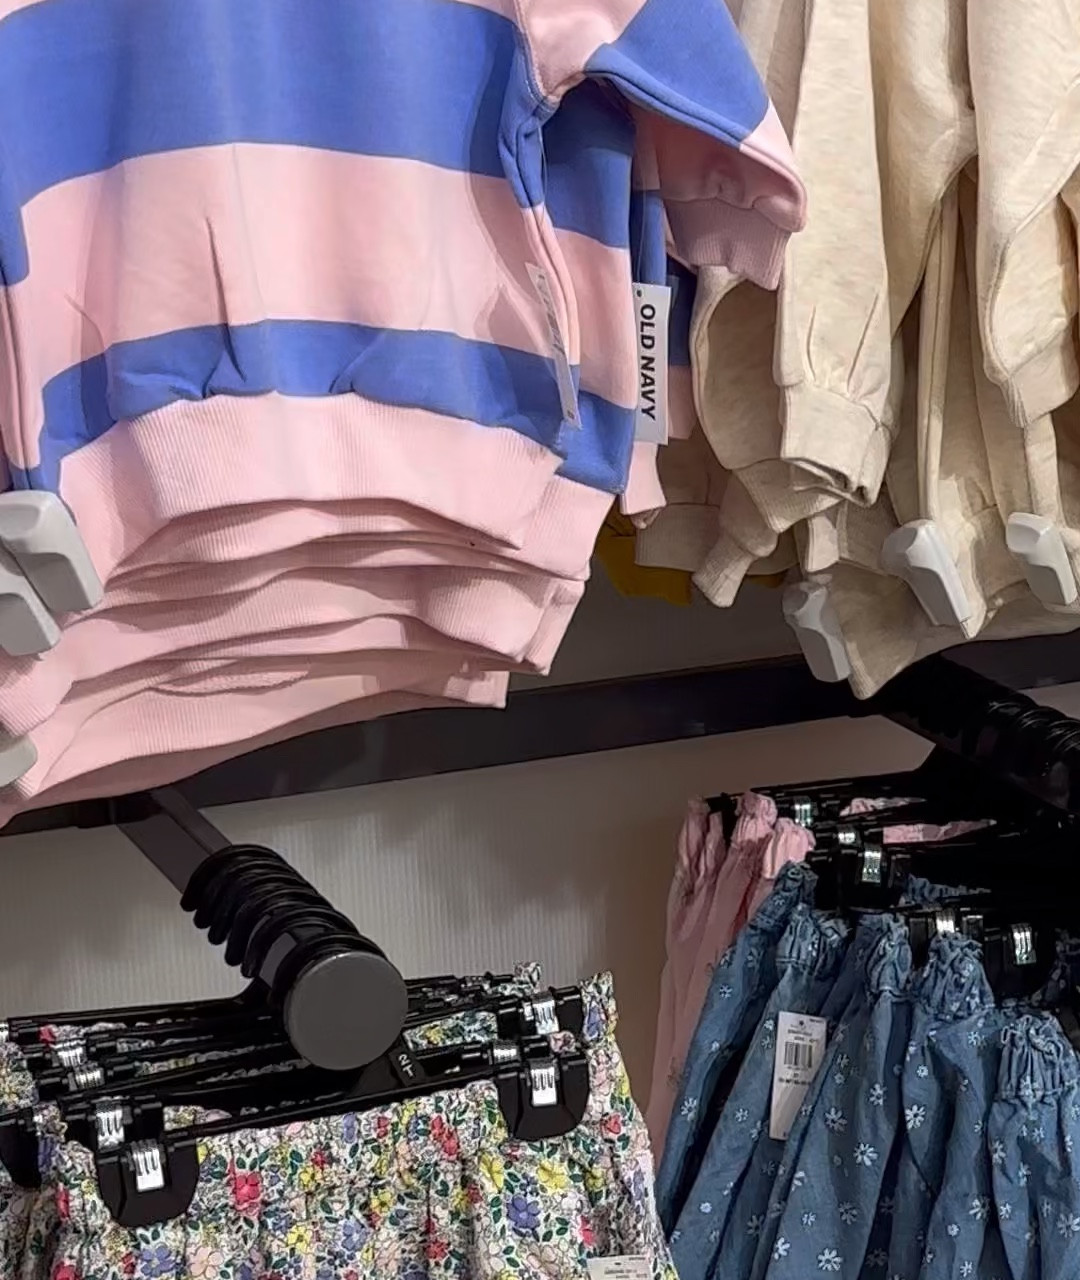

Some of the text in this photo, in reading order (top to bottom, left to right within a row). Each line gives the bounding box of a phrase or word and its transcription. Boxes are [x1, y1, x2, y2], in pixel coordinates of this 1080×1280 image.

[640, 304, 656, 421] OLD NAVY
[399, 1053, 413, 1077] 2T
